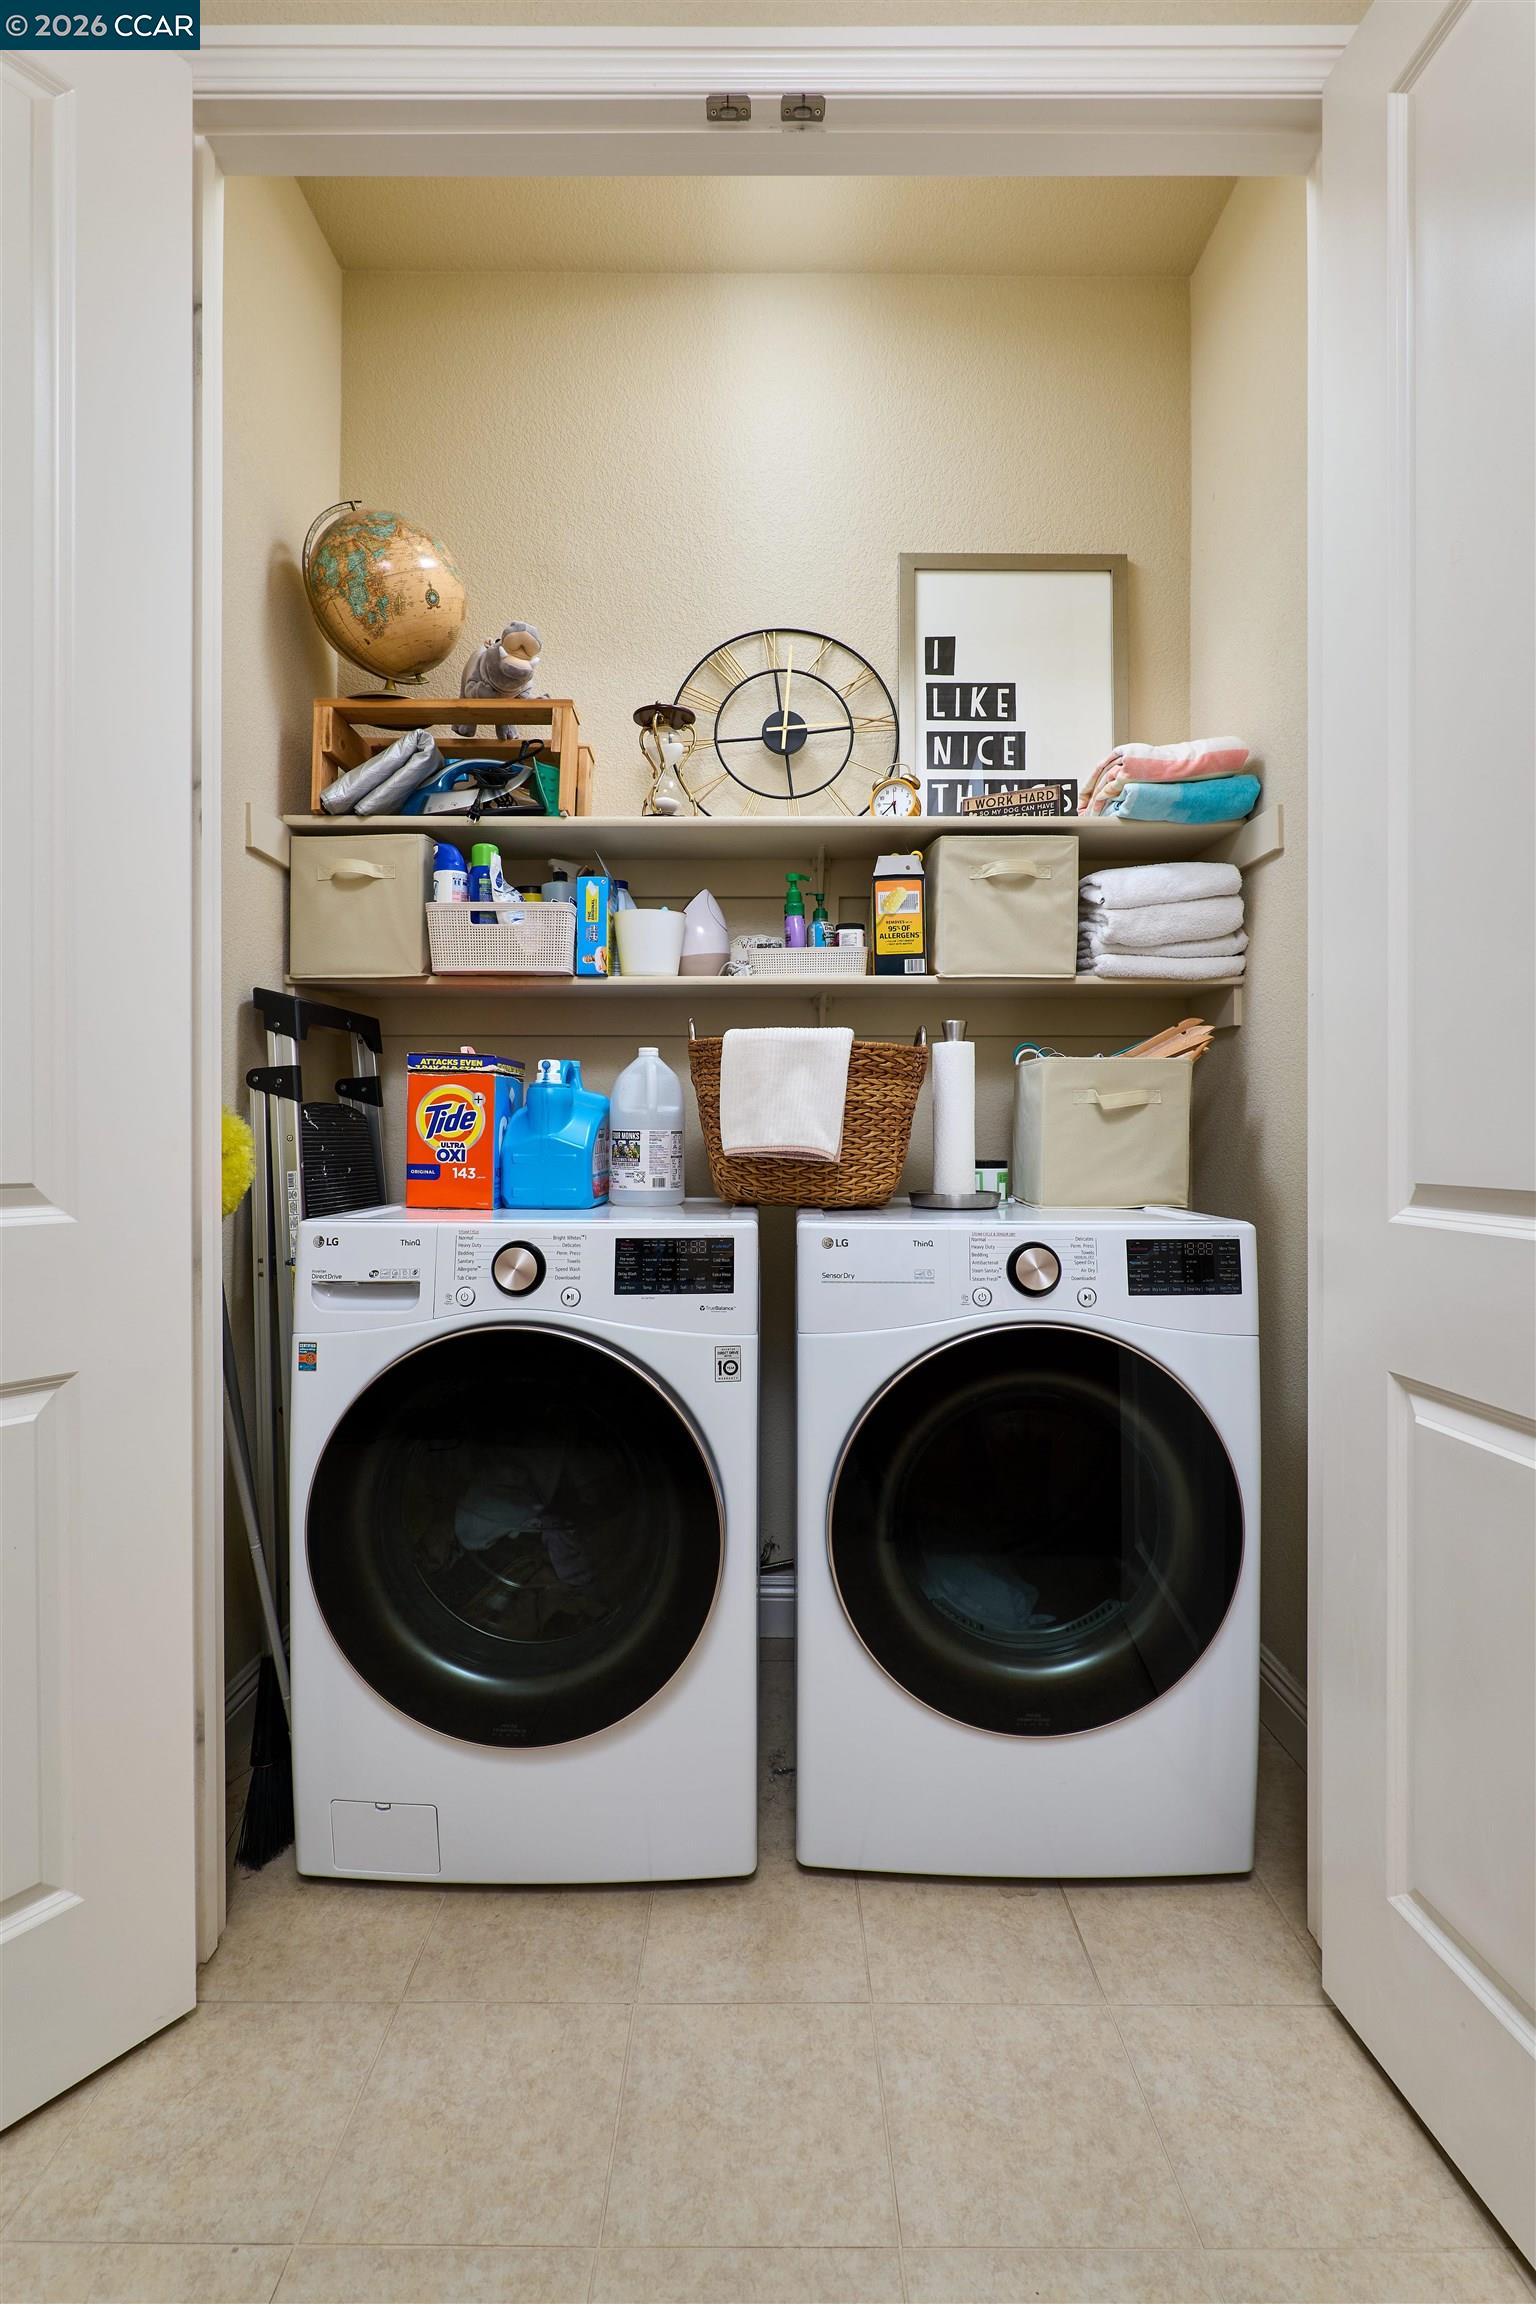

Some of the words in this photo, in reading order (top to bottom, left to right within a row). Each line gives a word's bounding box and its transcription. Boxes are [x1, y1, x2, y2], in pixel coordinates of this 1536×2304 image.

[933, 639, 939, 670] I
[932, 686, 1010, 718] LIKE
[933, 735, 1016, 766] NICE
[975, 795, 1013, 810] WORK
[1019, 790, 1054, 804] HARD
[1004, 806, 1019, 815] DOG
[1021, 804, 1035, 812] CAN
[1037, 802, 1055, 810] HAVE
[420, 1058, 459, 1066] ATTACKS
[460, 1059, 483, 1067] EVEN
[425, 1102, 477, 1140] Tide
[621, 1131, 640, 1140] MONKS
[436, 1149, 466, 1162] OXI
[452, 1167, 477, 1179] 143
[326, 1237, 339, 1246] LG
[400, 1239, 421, 1247] ThinQ
[835, 1238, 849, 1247] LG
[717, 1360, 739, 1376] 10
